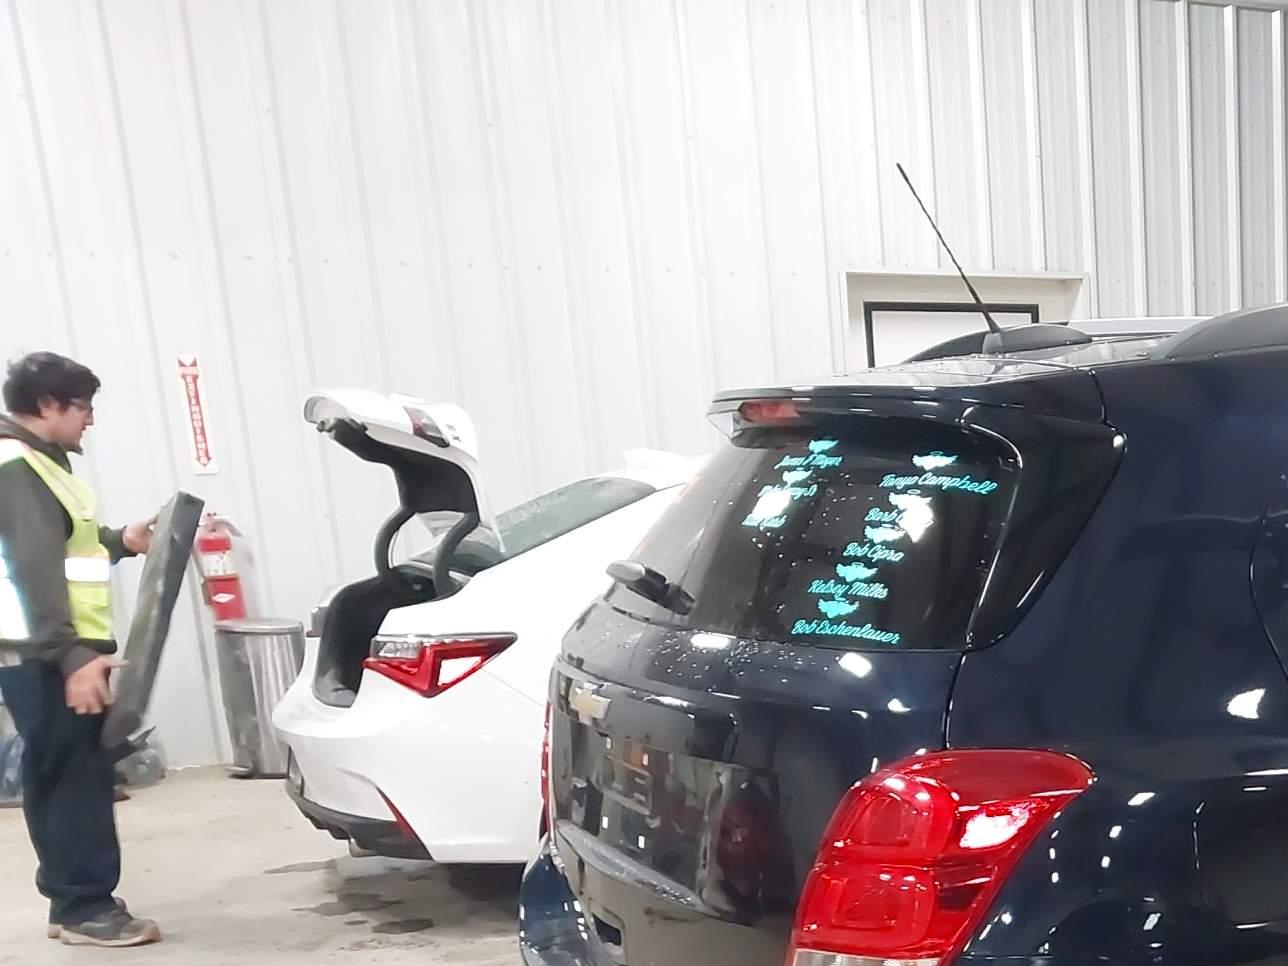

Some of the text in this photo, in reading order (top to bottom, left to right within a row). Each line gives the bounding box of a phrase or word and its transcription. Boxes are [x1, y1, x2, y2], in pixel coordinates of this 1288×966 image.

[918, 472, 998, 494] Campbell
[864, 507, 898, 521] Barb
[842, 542, 870, 557] Bob
[807, 579, 850, 597] Kelsey
[791, 619, 901, 645] Bob Eschenlauer
